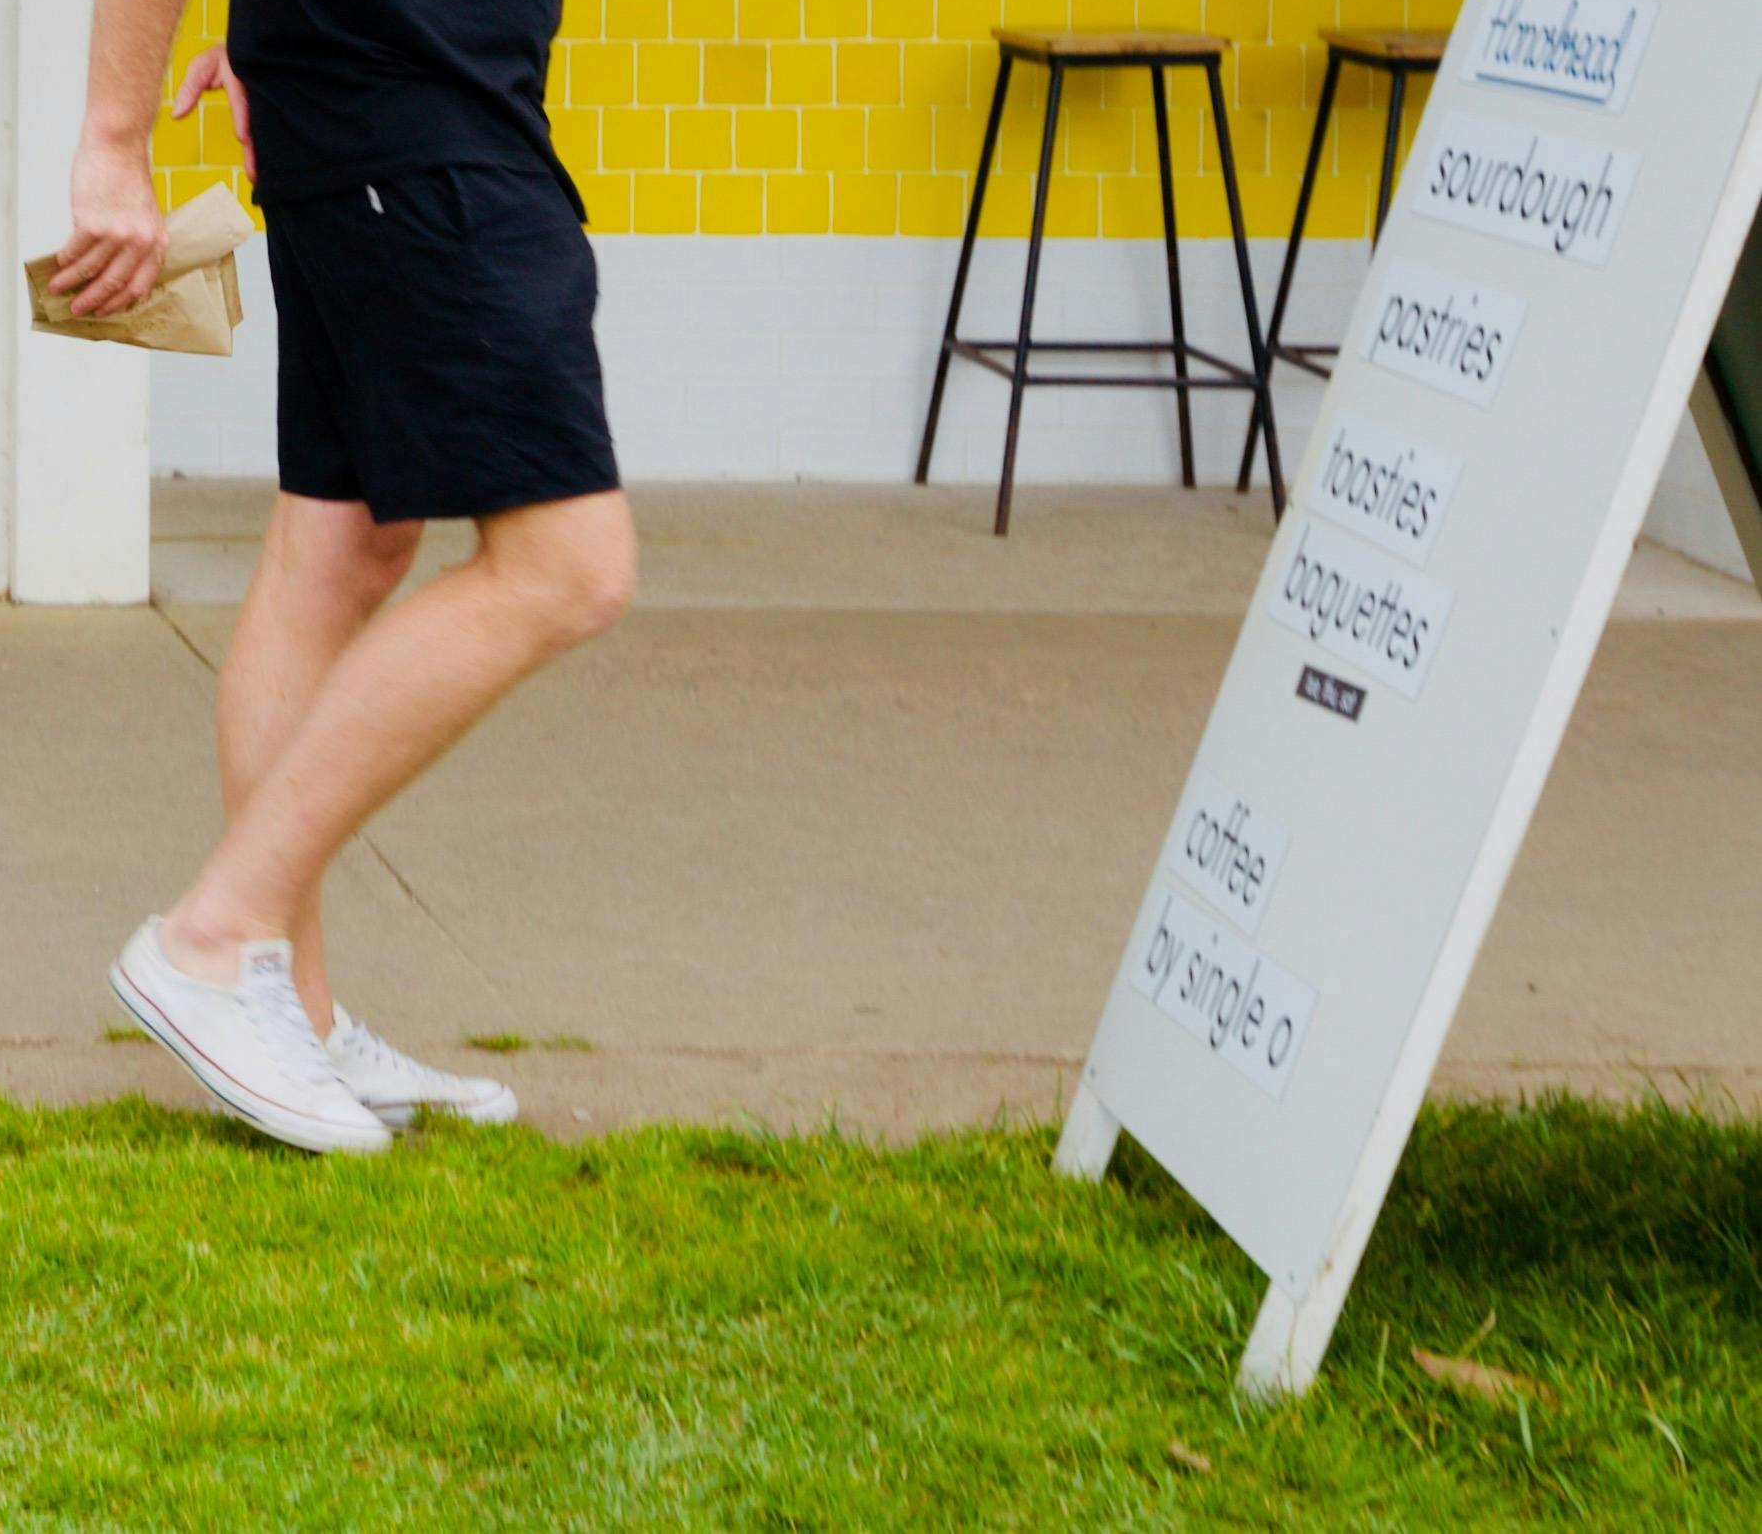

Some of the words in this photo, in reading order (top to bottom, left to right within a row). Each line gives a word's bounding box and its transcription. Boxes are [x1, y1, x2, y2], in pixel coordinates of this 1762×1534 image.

[1430, 135, 1614, 253] sourdough
[1370, 293, 1502, 381] pastries
[1321, 426, 1437, 539] toasties
[1283, 521, 1429, 670] baguettes
[1185, 799, 1266, 907] coffee
[1146, 893, 1185, 1006] by
[1179, 931, 1267, 1052] single
[1266, 1013, 1294, 1071] o
